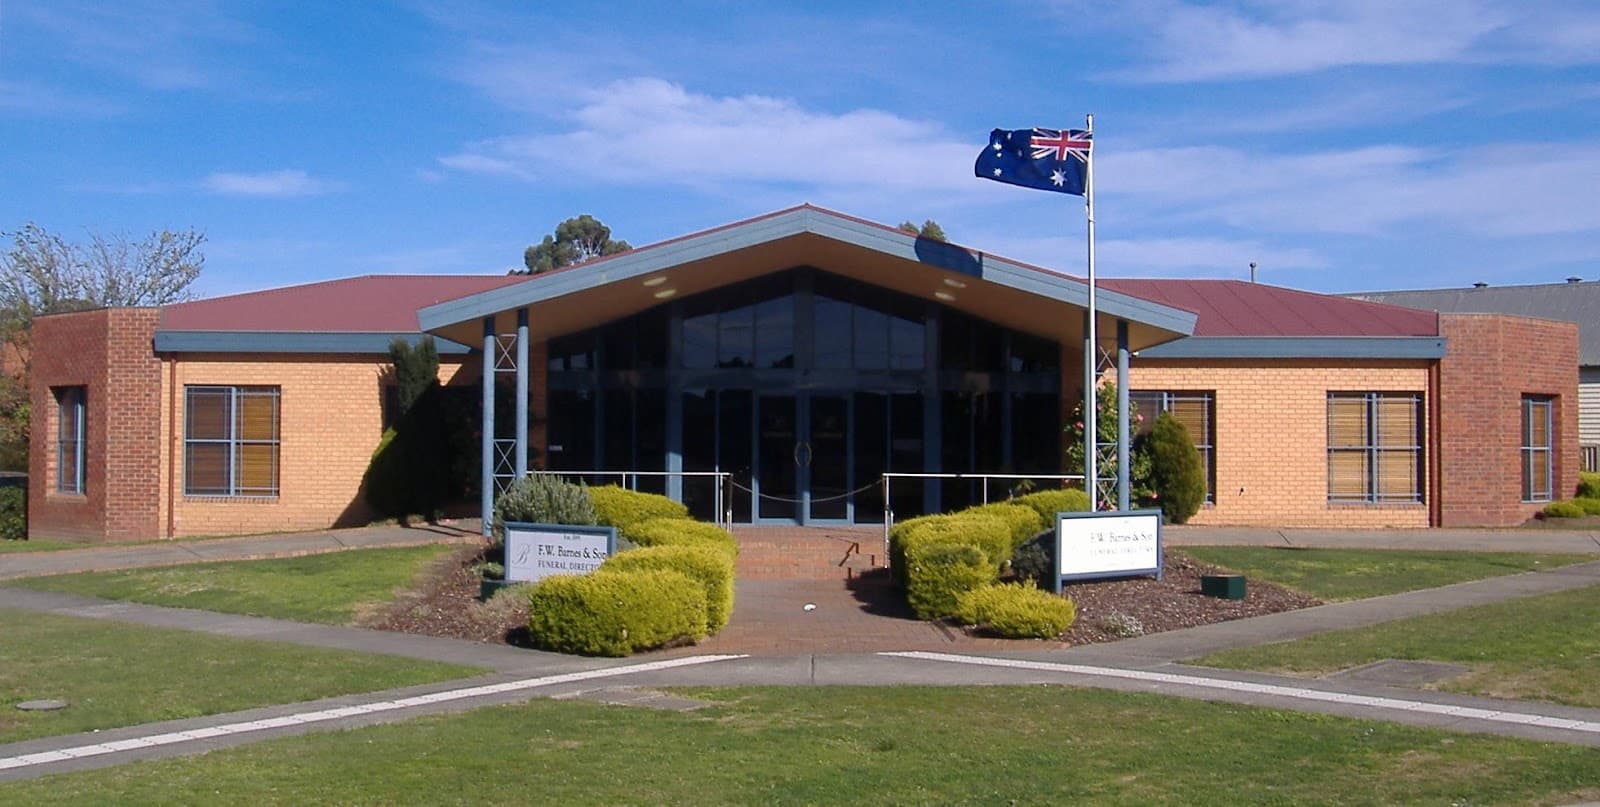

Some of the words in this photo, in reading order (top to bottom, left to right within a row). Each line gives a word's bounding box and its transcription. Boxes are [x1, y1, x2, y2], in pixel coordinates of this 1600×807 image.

[538, 544, 555, 556] F.W.
[558, 545, 581, 558] Barnes
[583, 547, 590, 559] &
[592, 548, 608, 560] Son
[538, 560, 566, 570] FUNERAL
